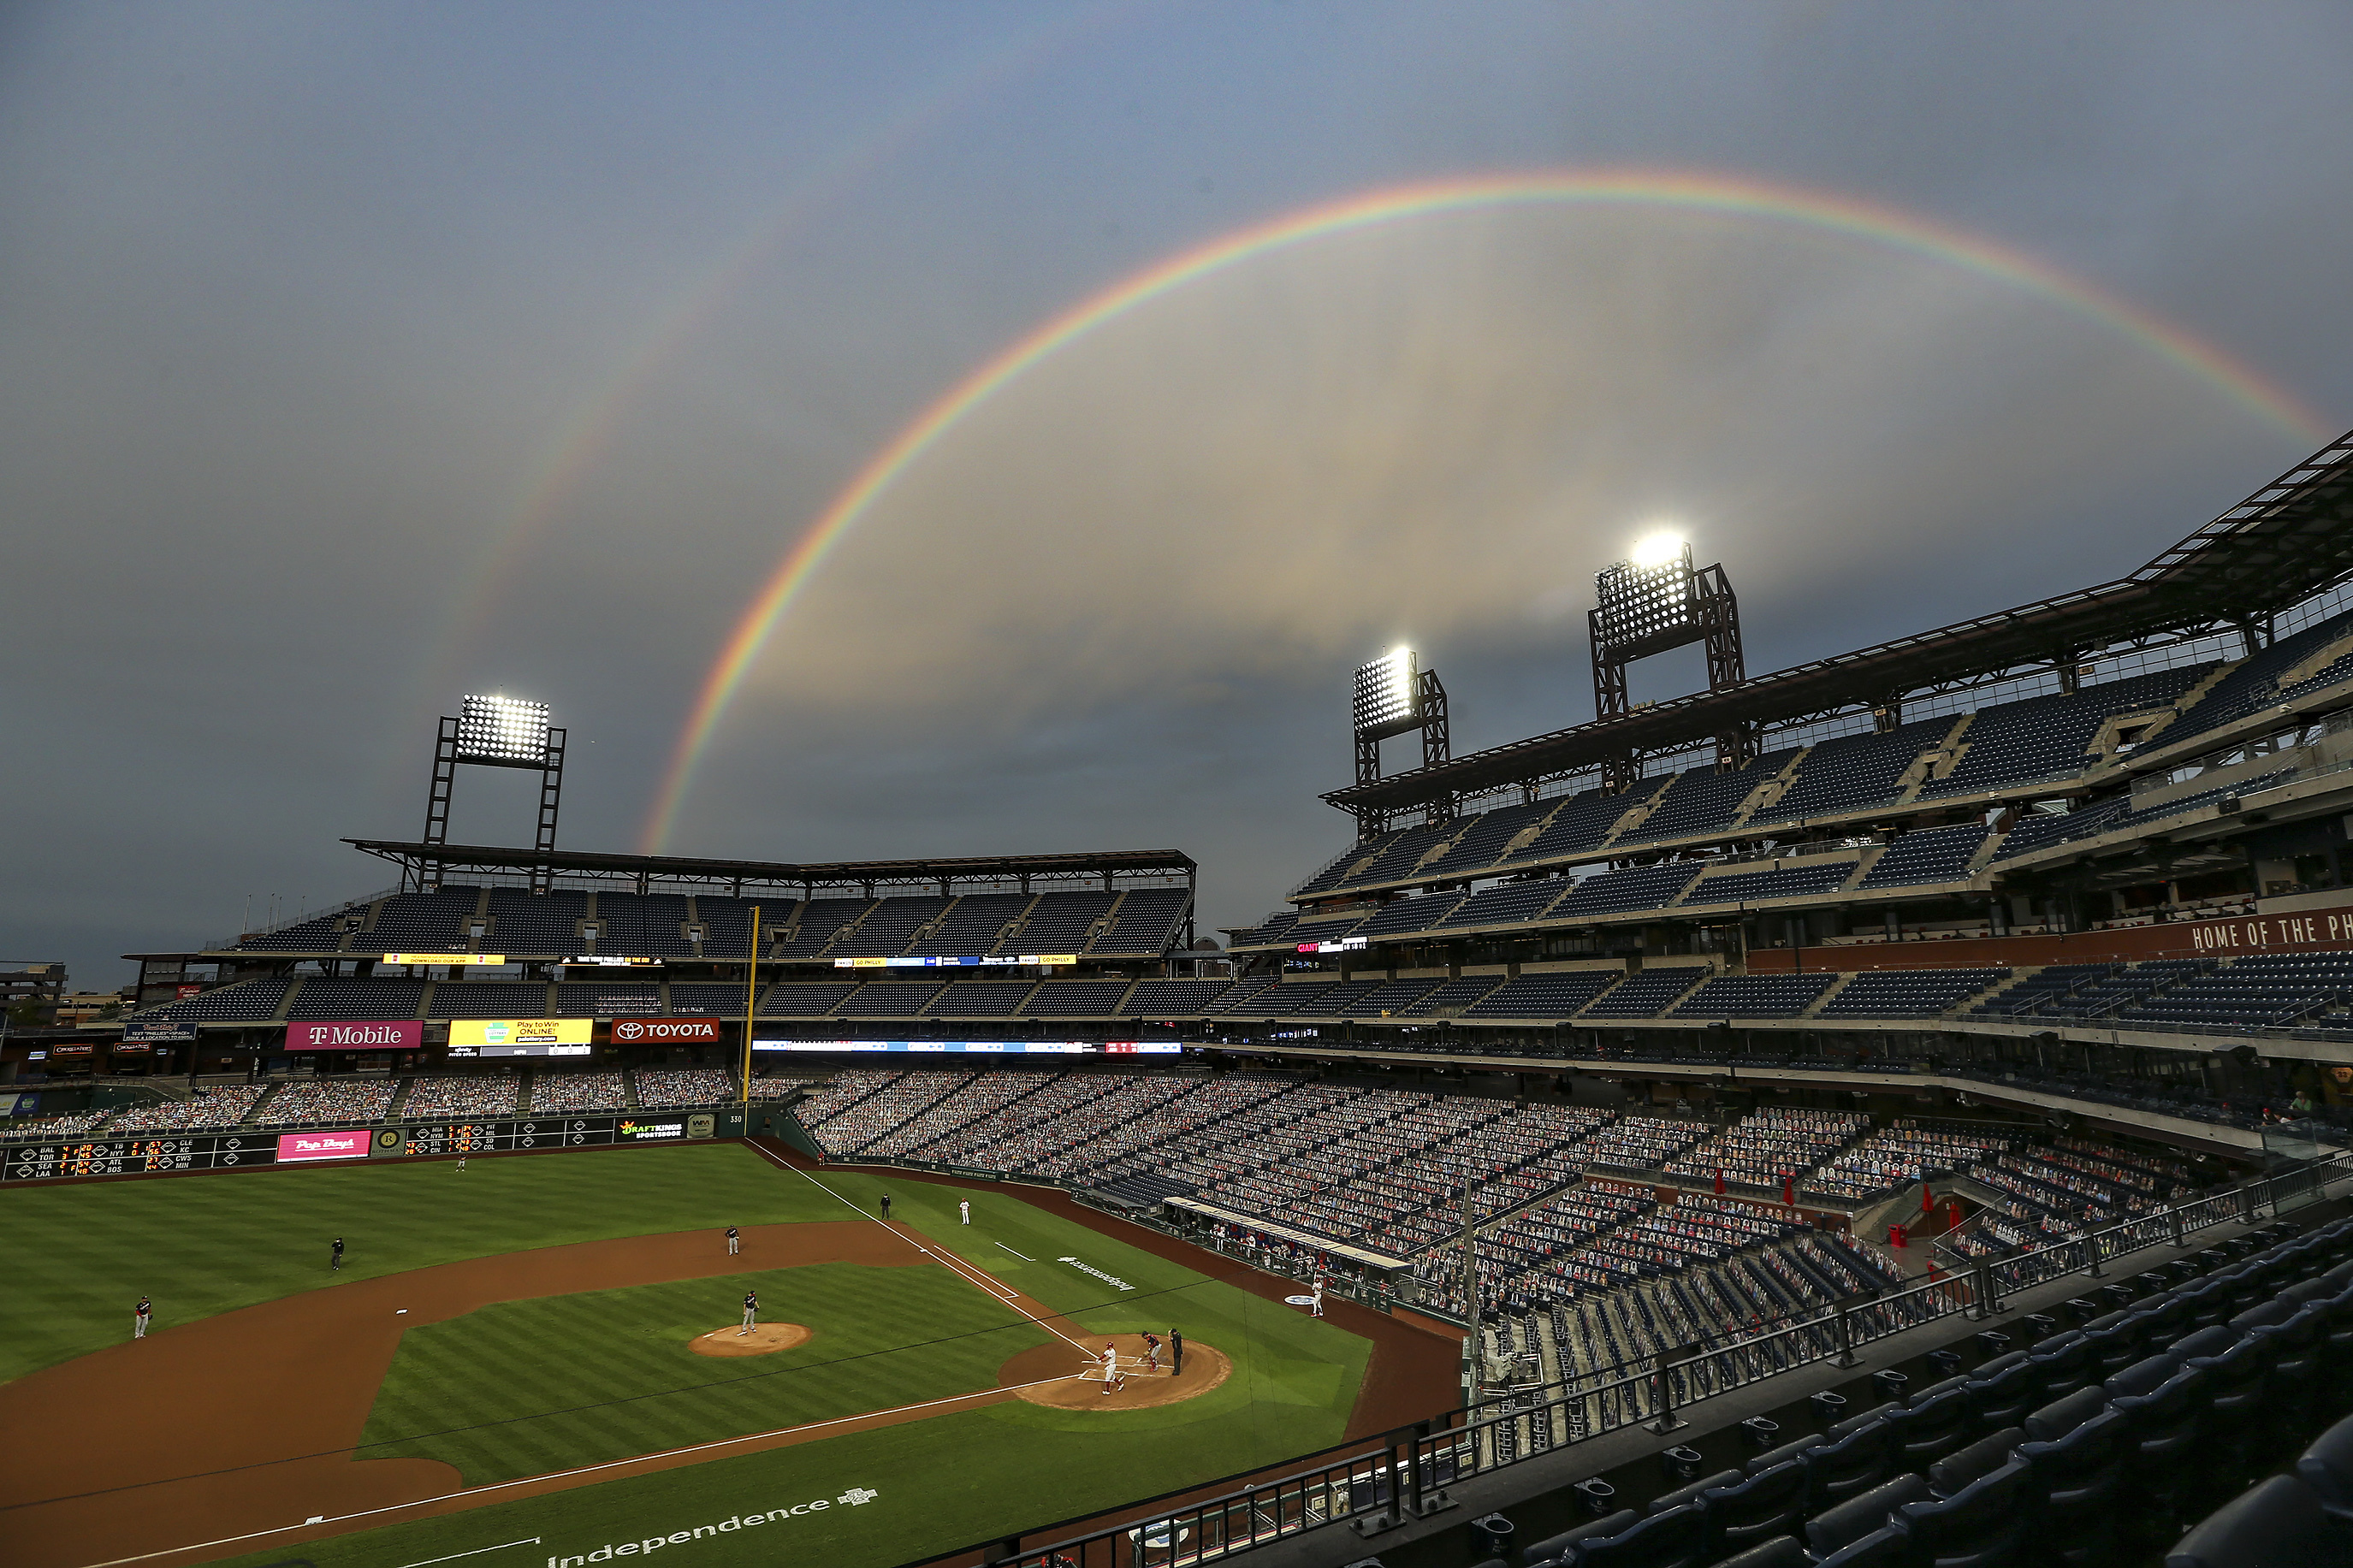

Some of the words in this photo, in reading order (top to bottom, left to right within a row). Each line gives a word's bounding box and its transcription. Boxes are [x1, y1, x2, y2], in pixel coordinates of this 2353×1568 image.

[2192, 925, 2239, 950] HOME
[2247, 921, 2267, 946] OF
[2279, 917, 2316, 943] THE
[1297, 944, 1319, 952] GIANT
[330, 1027, 402, 1044] Mobile
[646, 1024, 714, 1037] TOYOTA
[730, 1115, 742, 1123] 330
[621, 1123, 683, 1135] DRAFTKINGS
[636, 1131, 682, 1139] SPORTSBOOK
[385, 1134, 394, 1143] R
[295, 1139, 322, 1150] Pep
[322, 1139, 355, 1151] Boys
[548, 1498, 831, 1568] Independence
